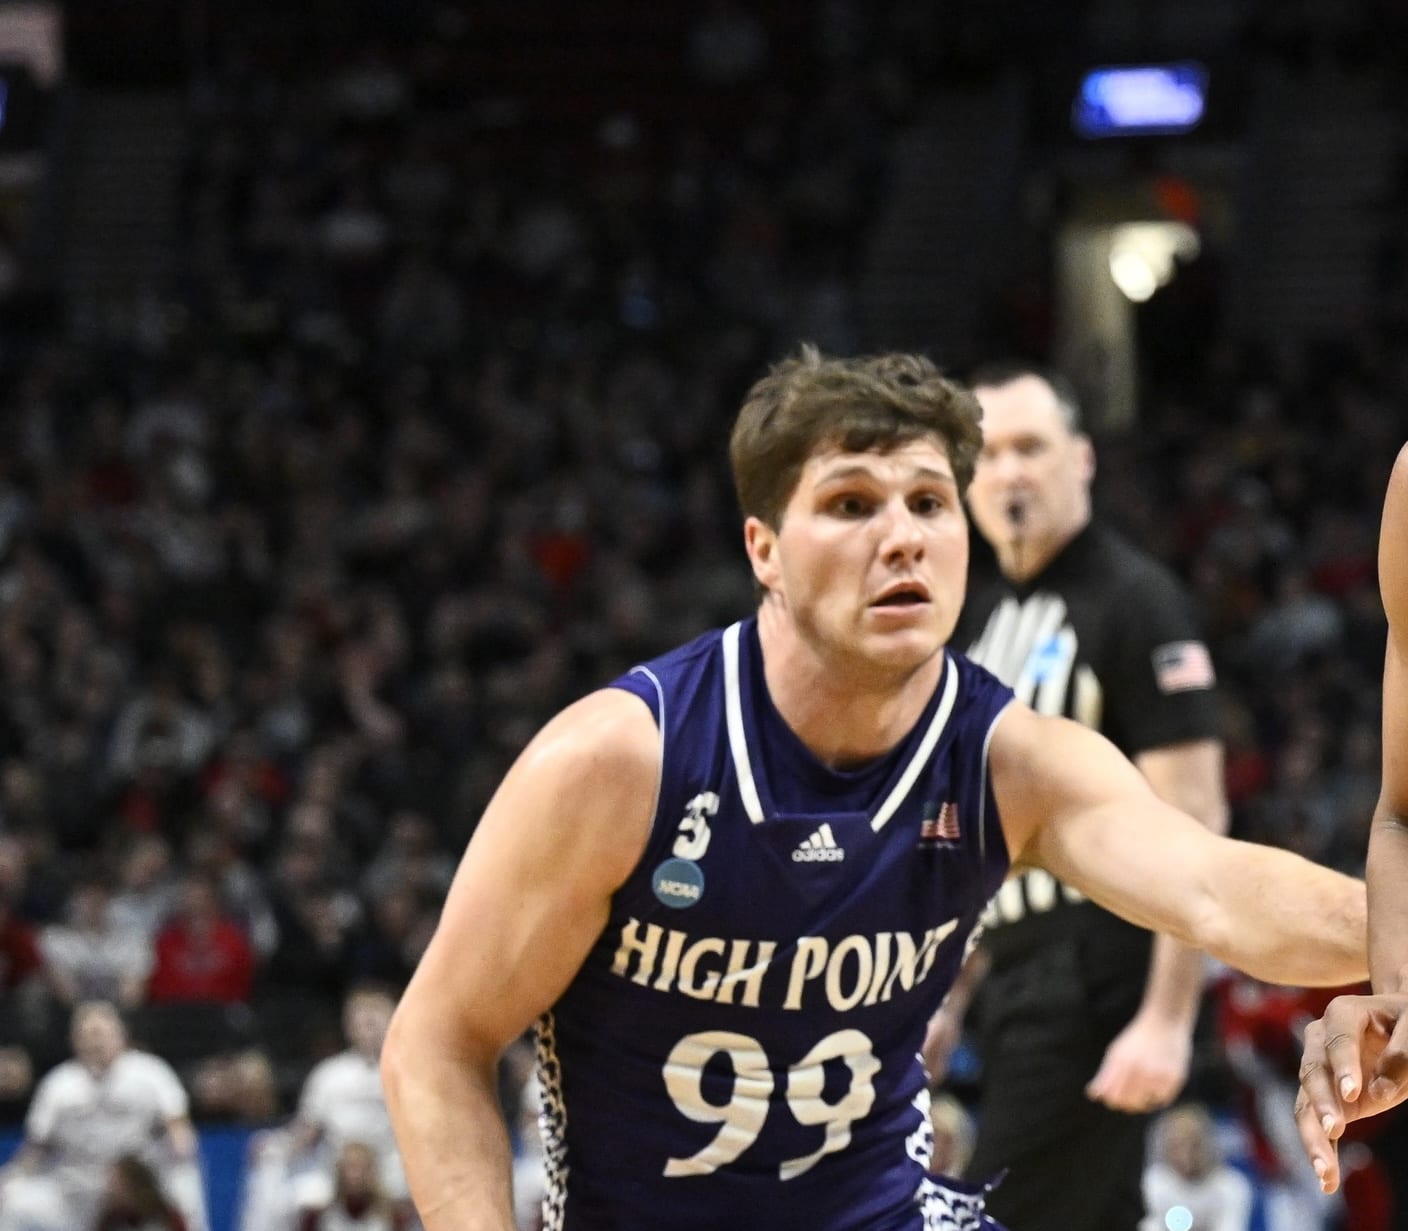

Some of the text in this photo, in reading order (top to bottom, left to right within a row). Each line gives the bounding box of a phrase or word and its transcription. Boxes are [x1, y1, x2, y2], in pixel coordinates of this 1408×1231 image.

[791, 848, 845, 863] adidas
[658, 879, 700, 901] NCAA
[610, 917, 960, 1013] HIGH POINT
[661, 1028, 883, 1182] 99
